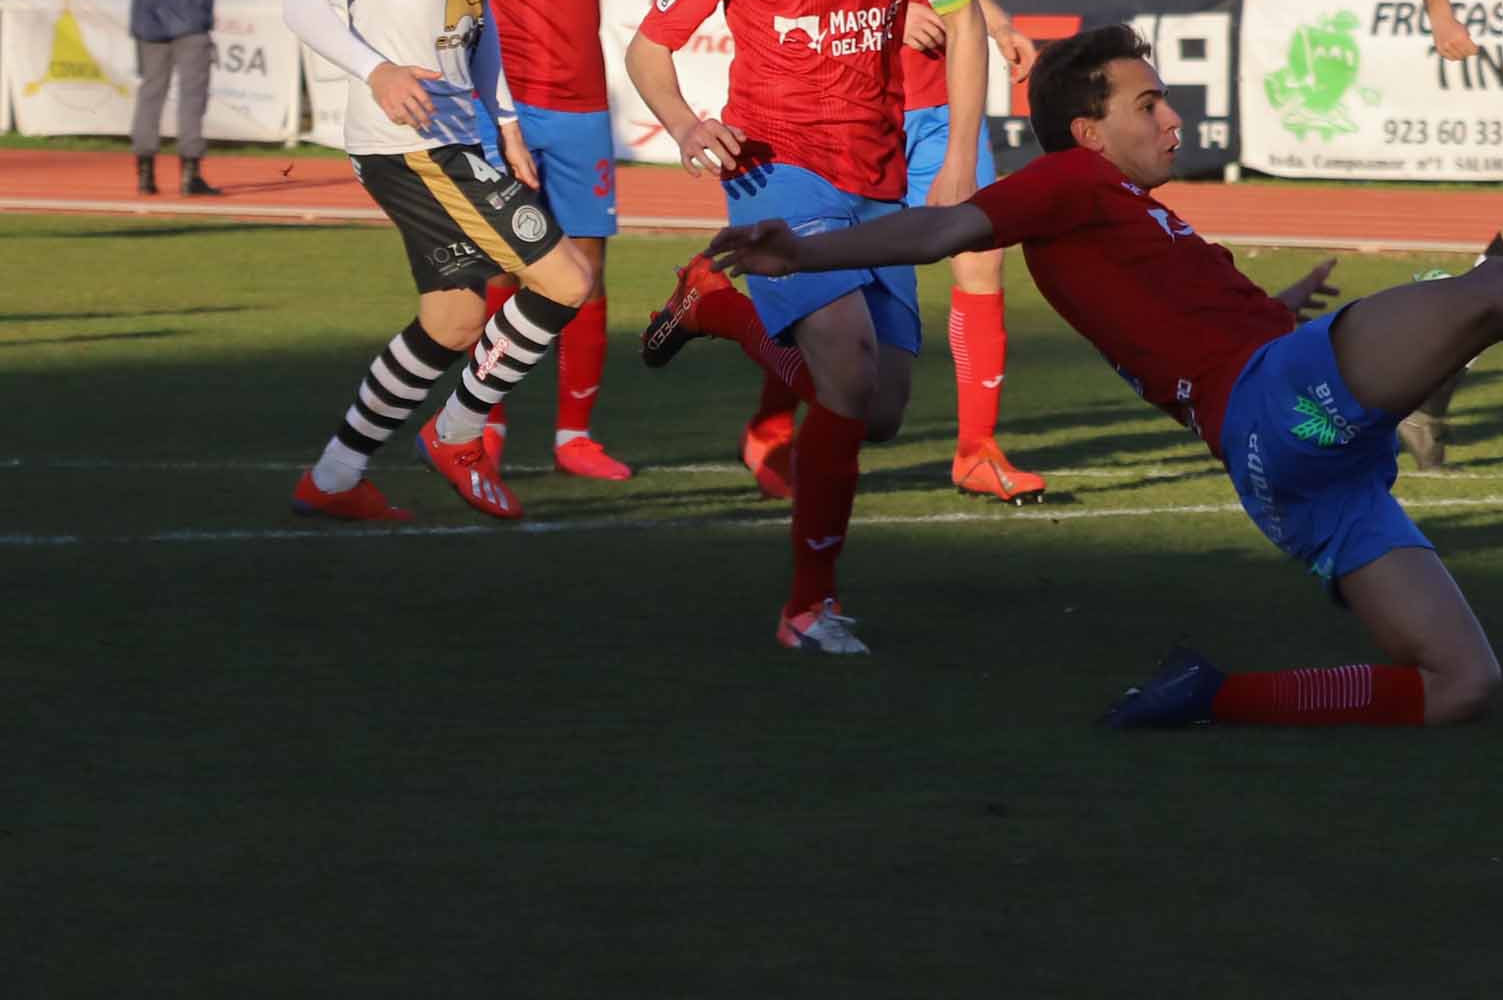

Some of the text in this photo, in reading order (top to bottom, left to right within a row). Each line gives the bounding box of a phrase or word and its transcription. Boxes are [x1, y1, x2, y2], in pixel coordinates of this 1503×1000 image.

[831, 38, 857, 56] DEL
[1384, 120, 1503, 145] 923 60 33
[593, 159, 613, 198] 3
